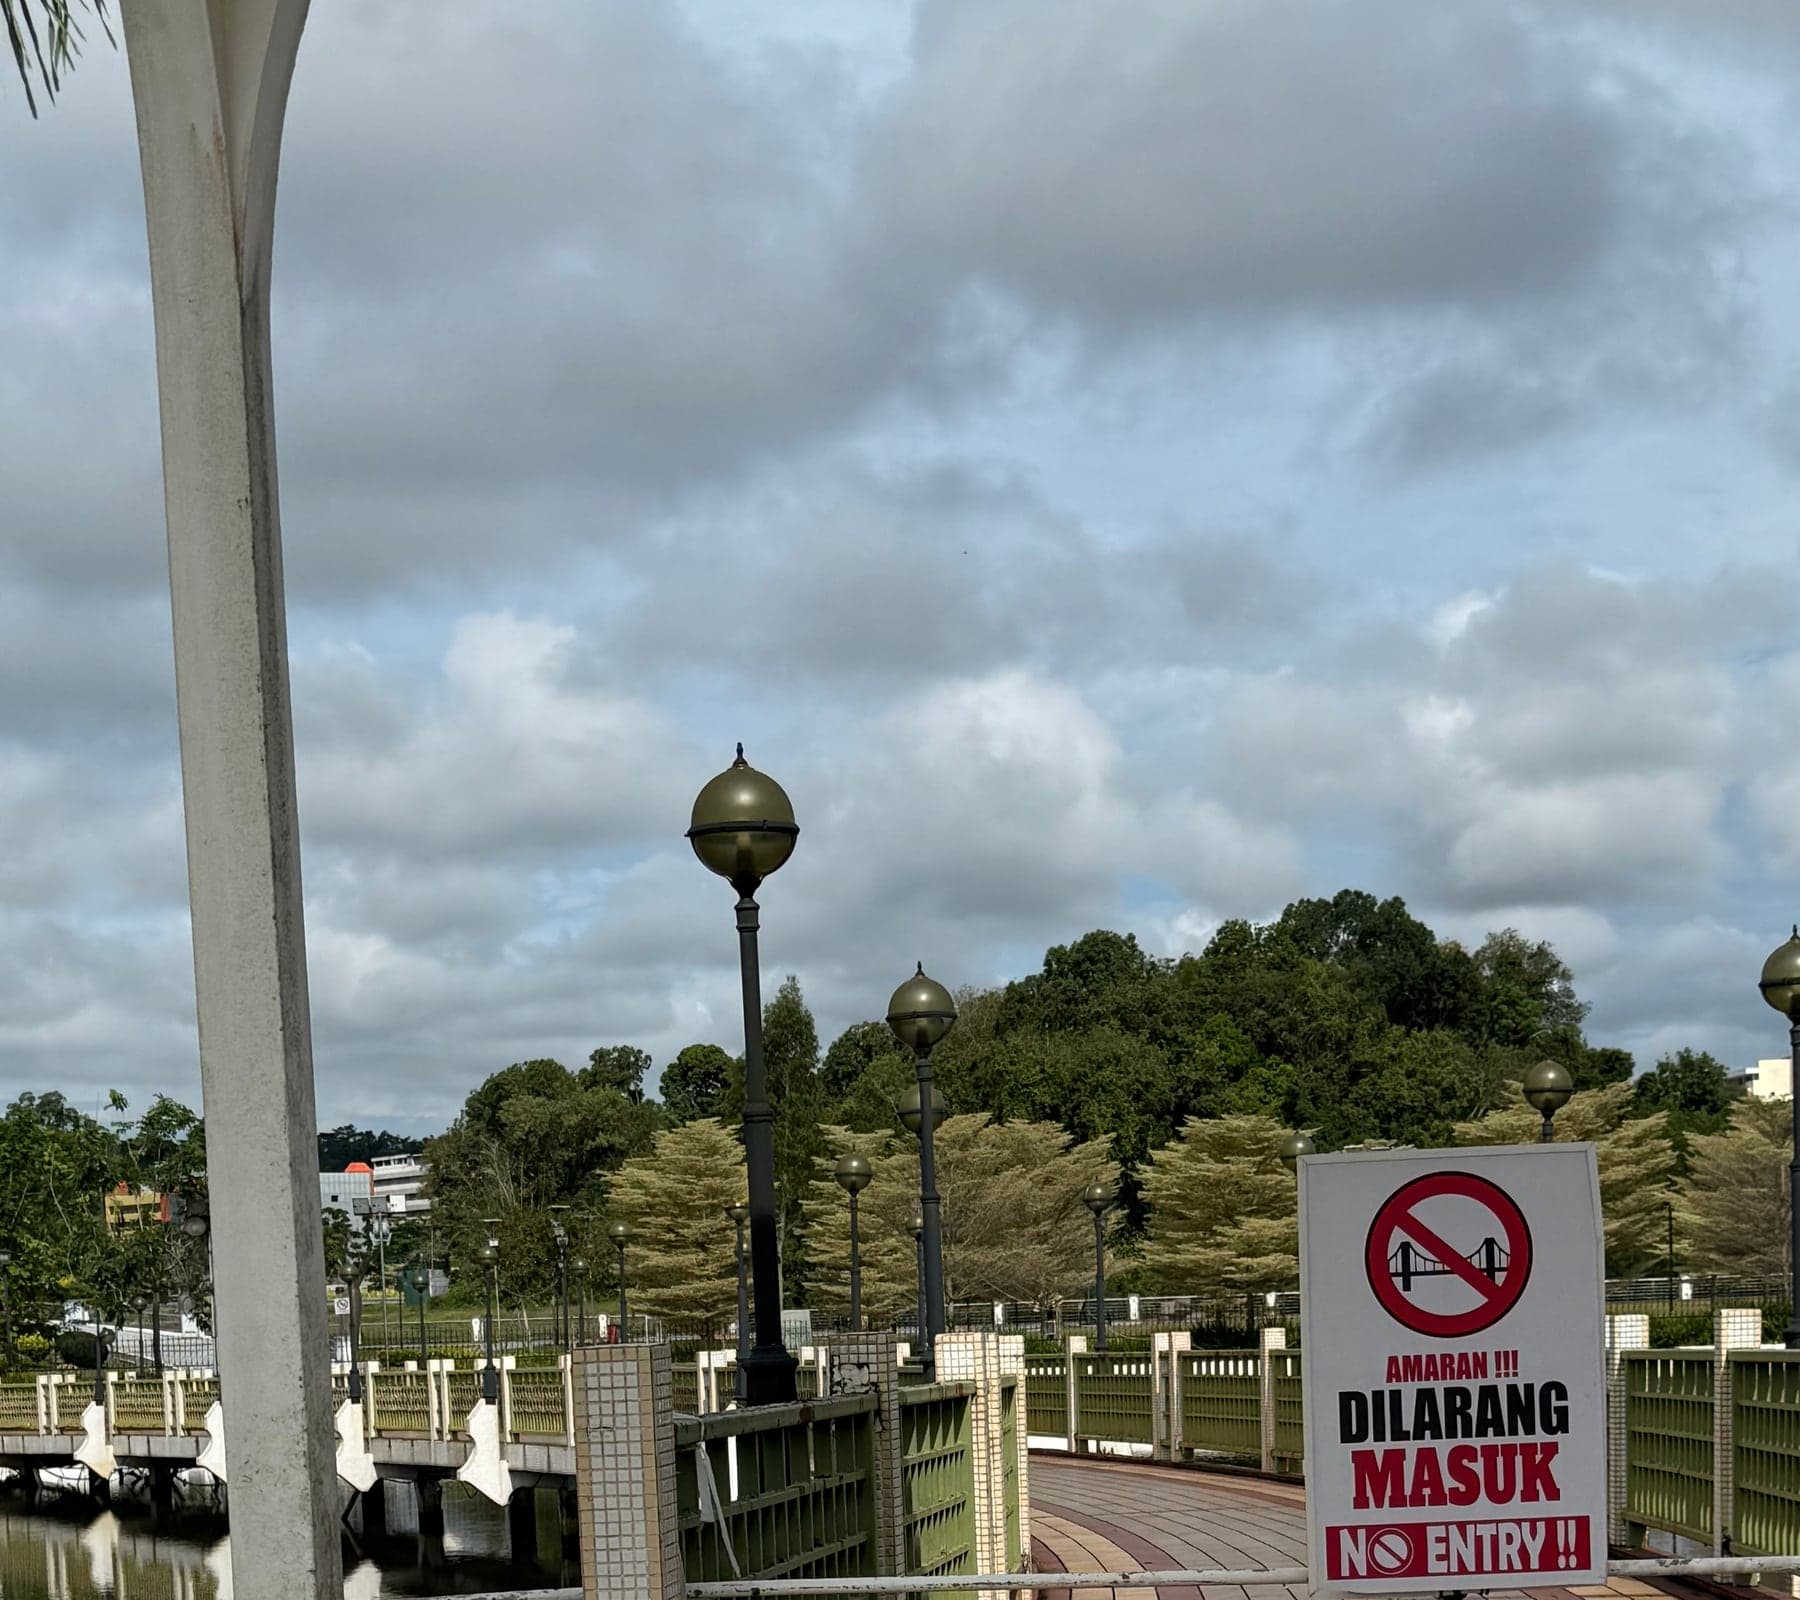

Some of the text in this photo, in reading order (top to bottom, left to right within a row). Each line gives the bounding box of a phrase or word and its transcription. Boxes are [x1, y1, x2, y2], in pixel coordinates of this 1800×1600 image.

[1385, 1350, 1519, 1383] AMARAN !!!
[1338, 1381, 1570, 1444] DILARANG
[1351, 1441, 1561, 1509] MASUK
[1426, 1521, 1547, 1574] ENTRY
[1556, 1519, 1578, 1569] !!
